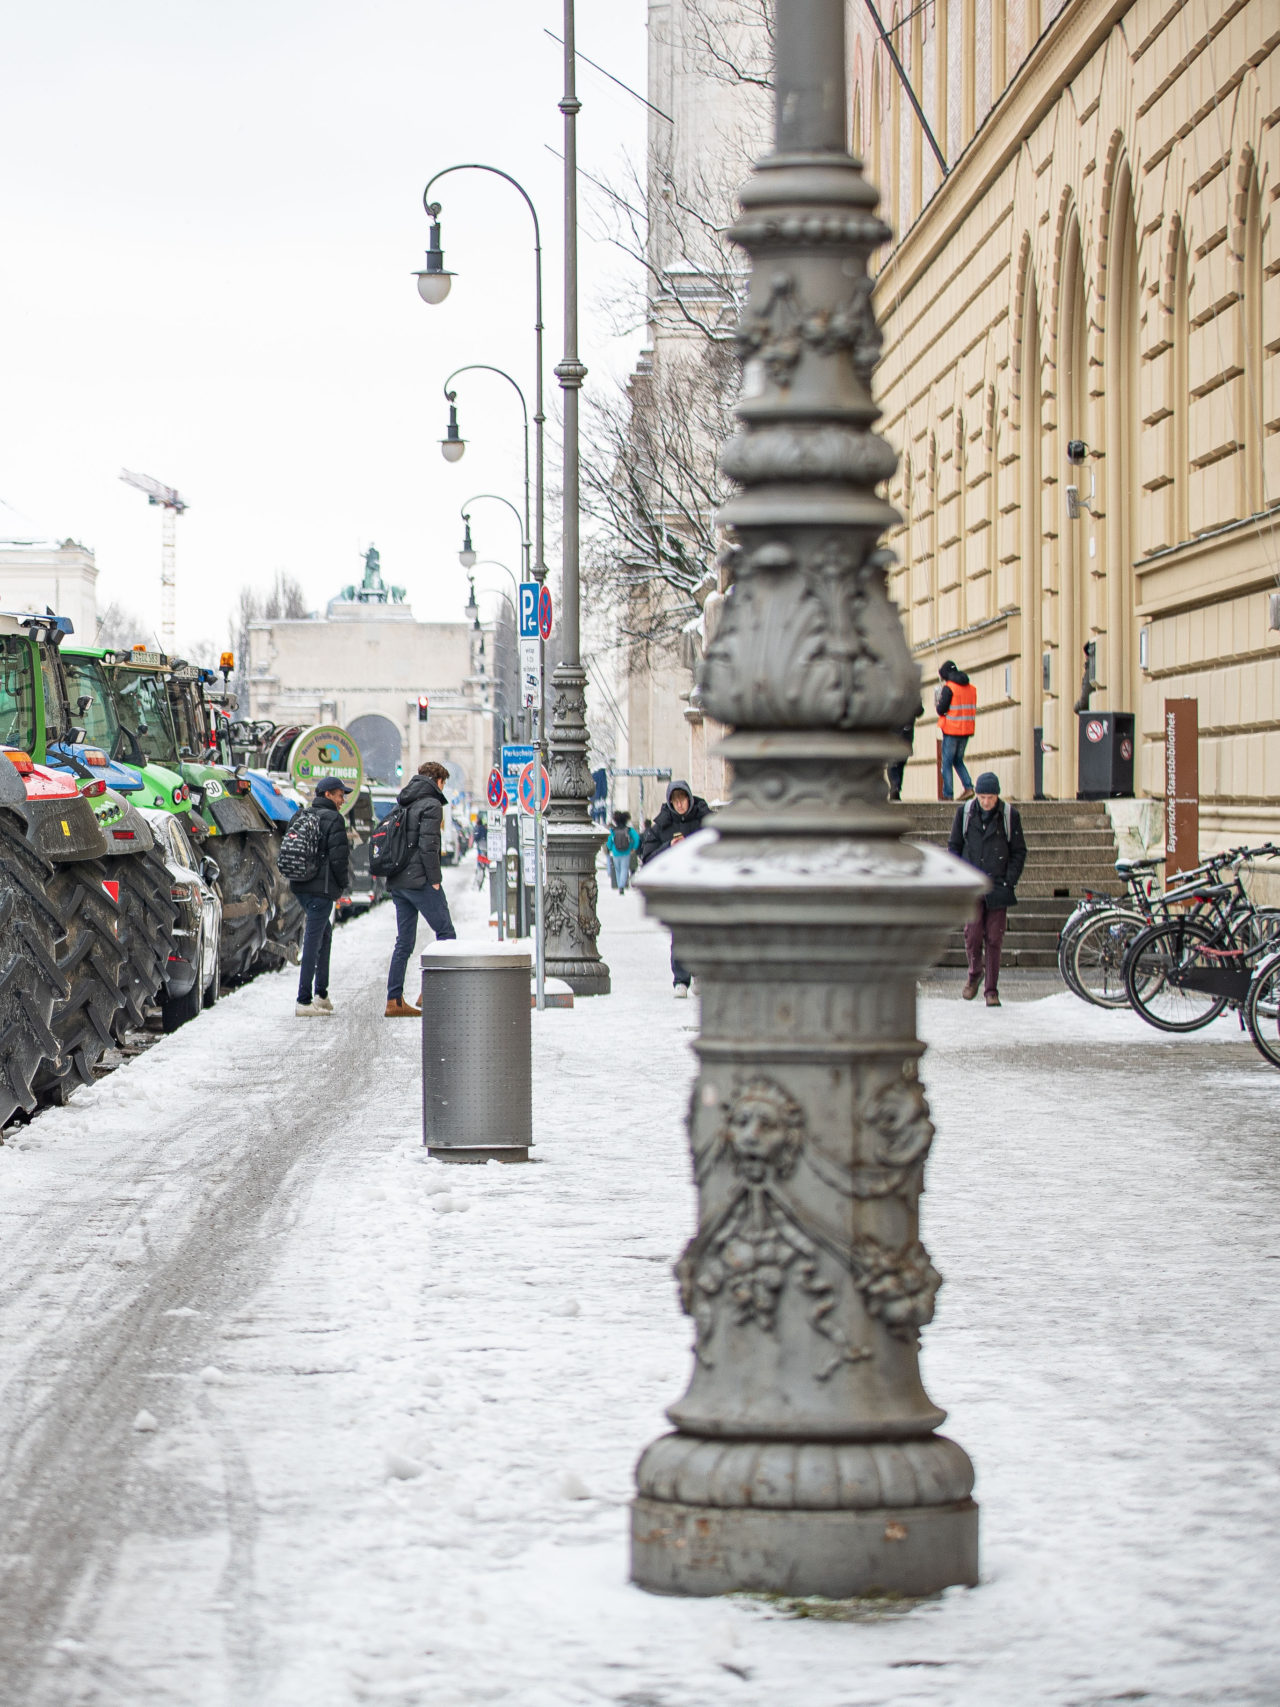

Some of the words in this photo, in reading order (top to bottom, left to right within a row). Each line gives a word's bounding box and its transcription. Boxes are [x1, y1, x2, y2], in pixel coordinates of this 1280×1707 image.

[1166, 712, 1176, 796] Staatsbibliothek
[206, 781, 220, 795] 50
[1167, 797, 1178, 853] Bayerische
